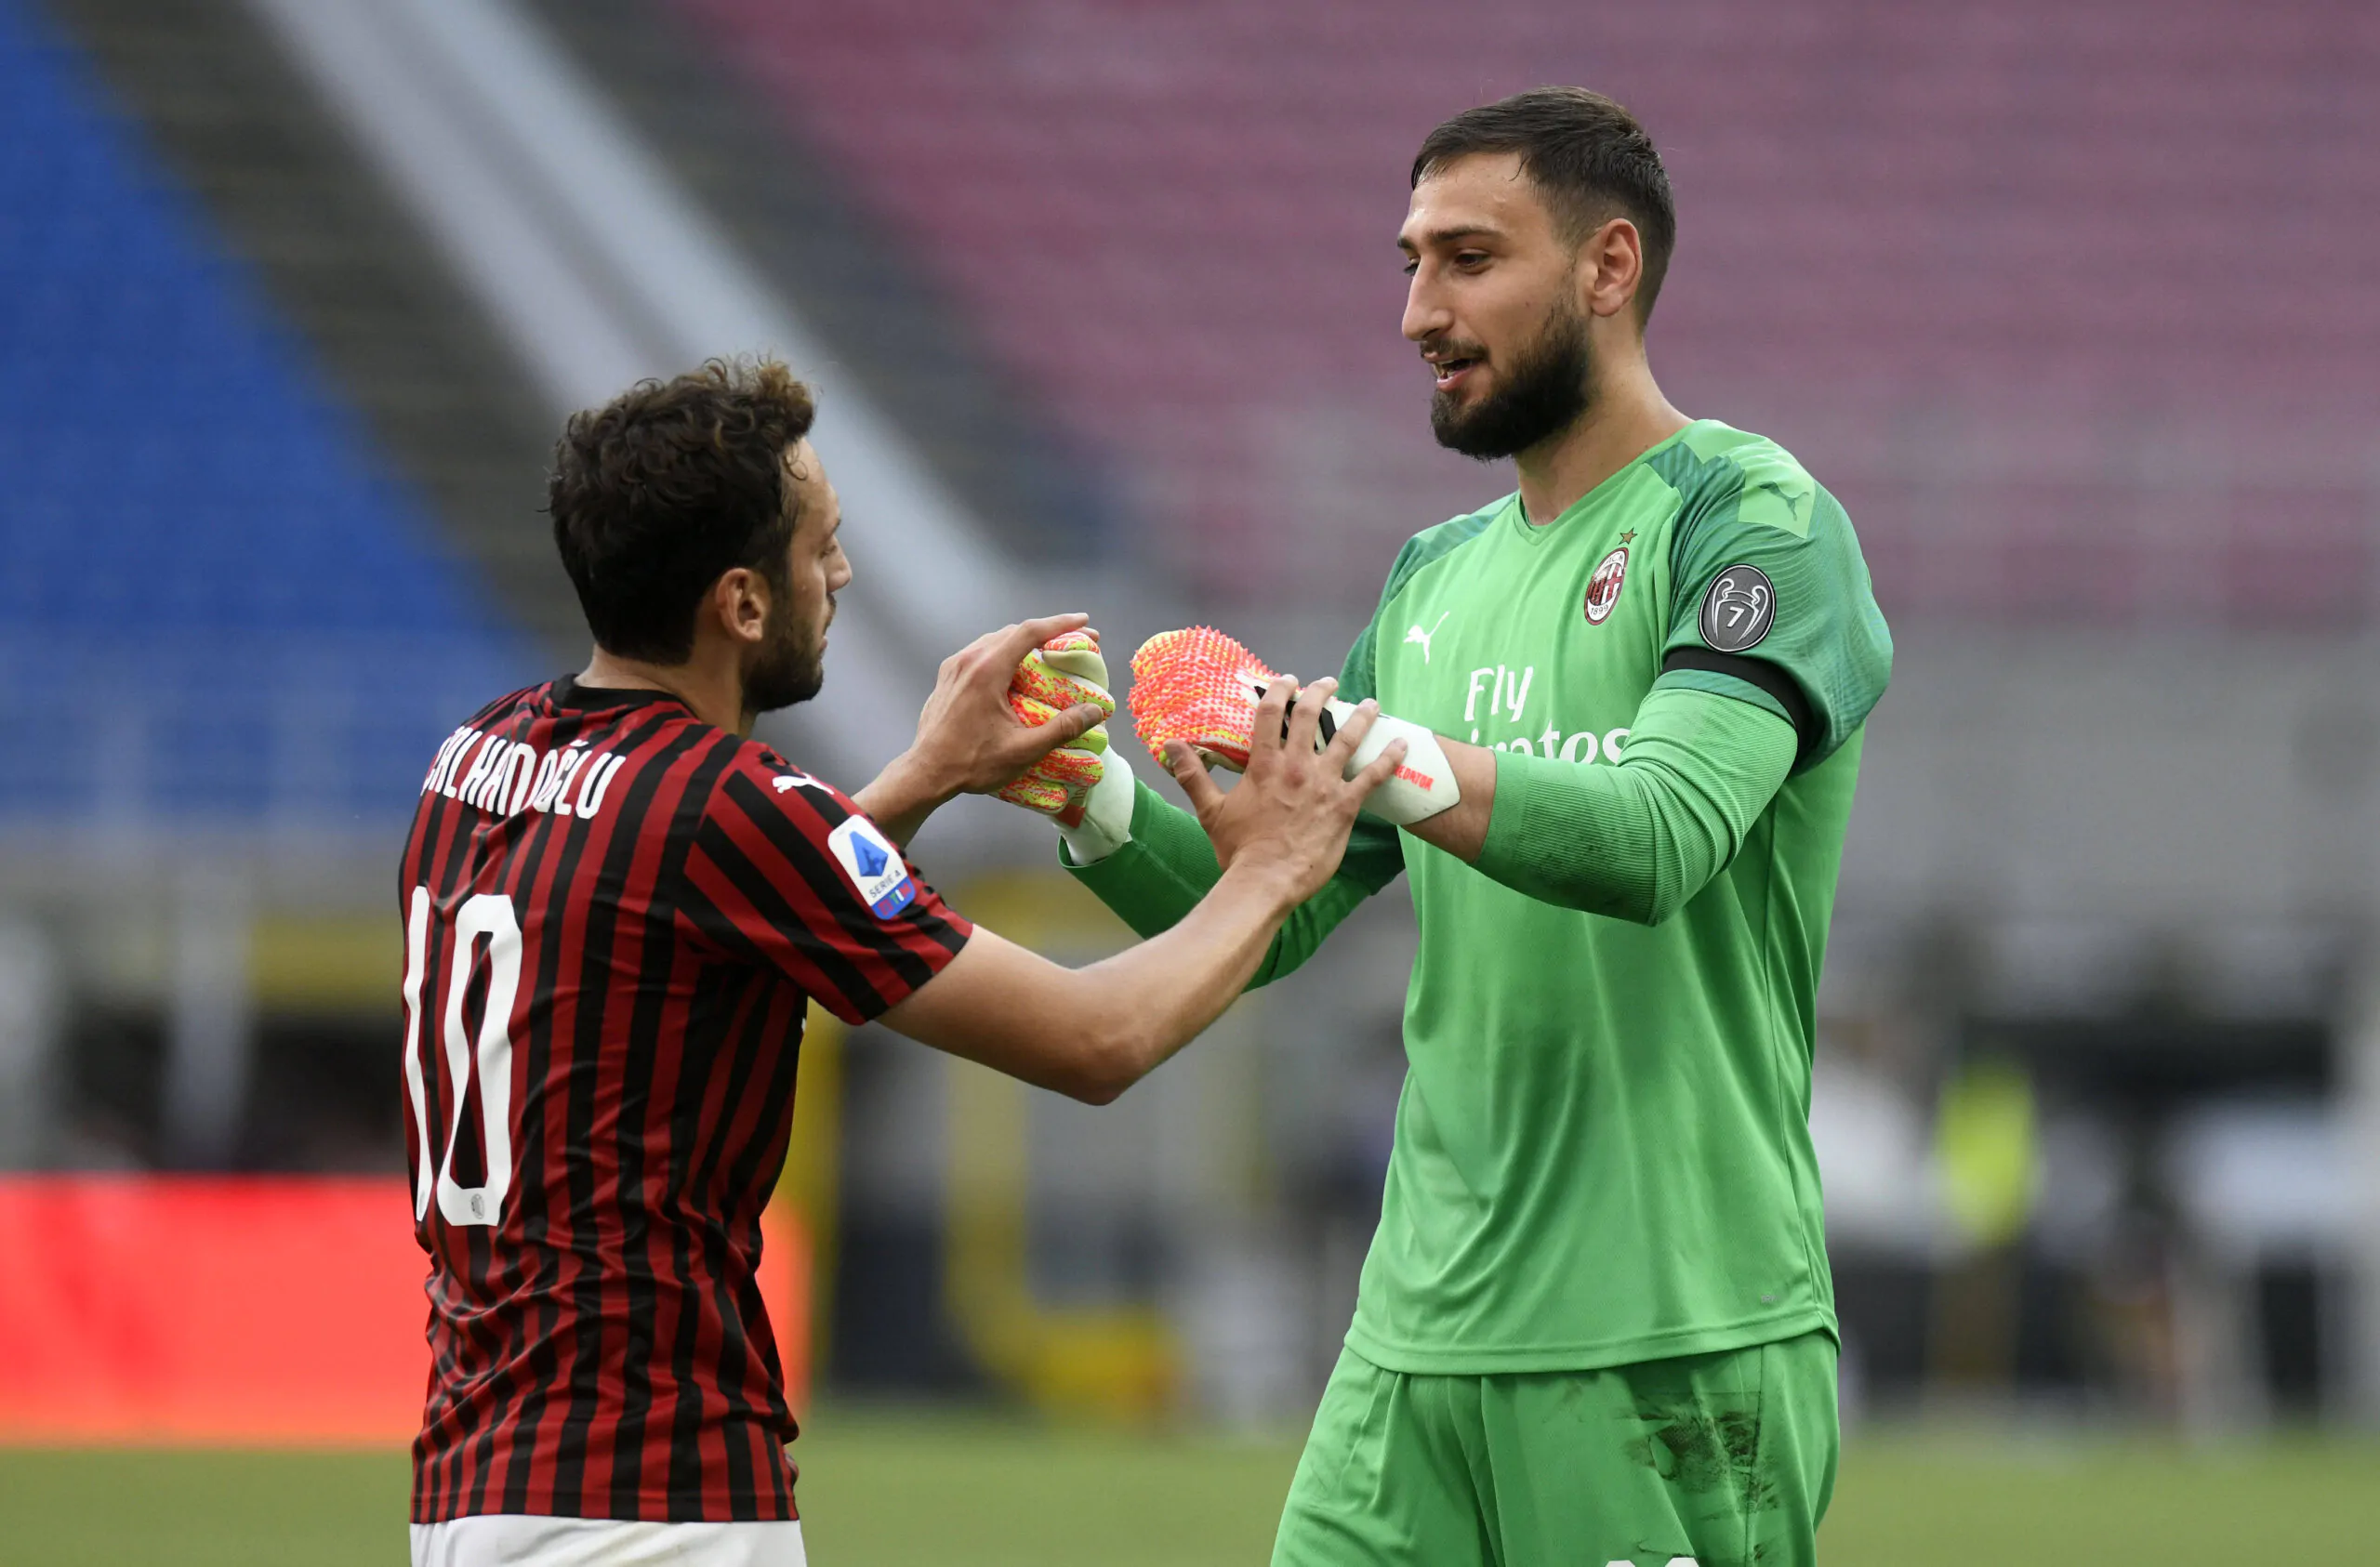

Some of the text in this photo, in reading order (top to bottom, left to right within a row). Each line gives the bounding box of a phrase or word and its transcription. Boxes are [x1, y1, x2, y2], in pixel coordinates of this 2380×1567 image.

[1591, 604, 1608, 615] 1899
[1727, 606, 1745, 628] 7
[1464, 664, 1534, 723] Fly
[1395, 764, 1434, 792] EDATOR
[869, 875, 893, 899] SERIE
[890, 882, 911, 905] TIM
[403, 885, 522, 1227] 10
